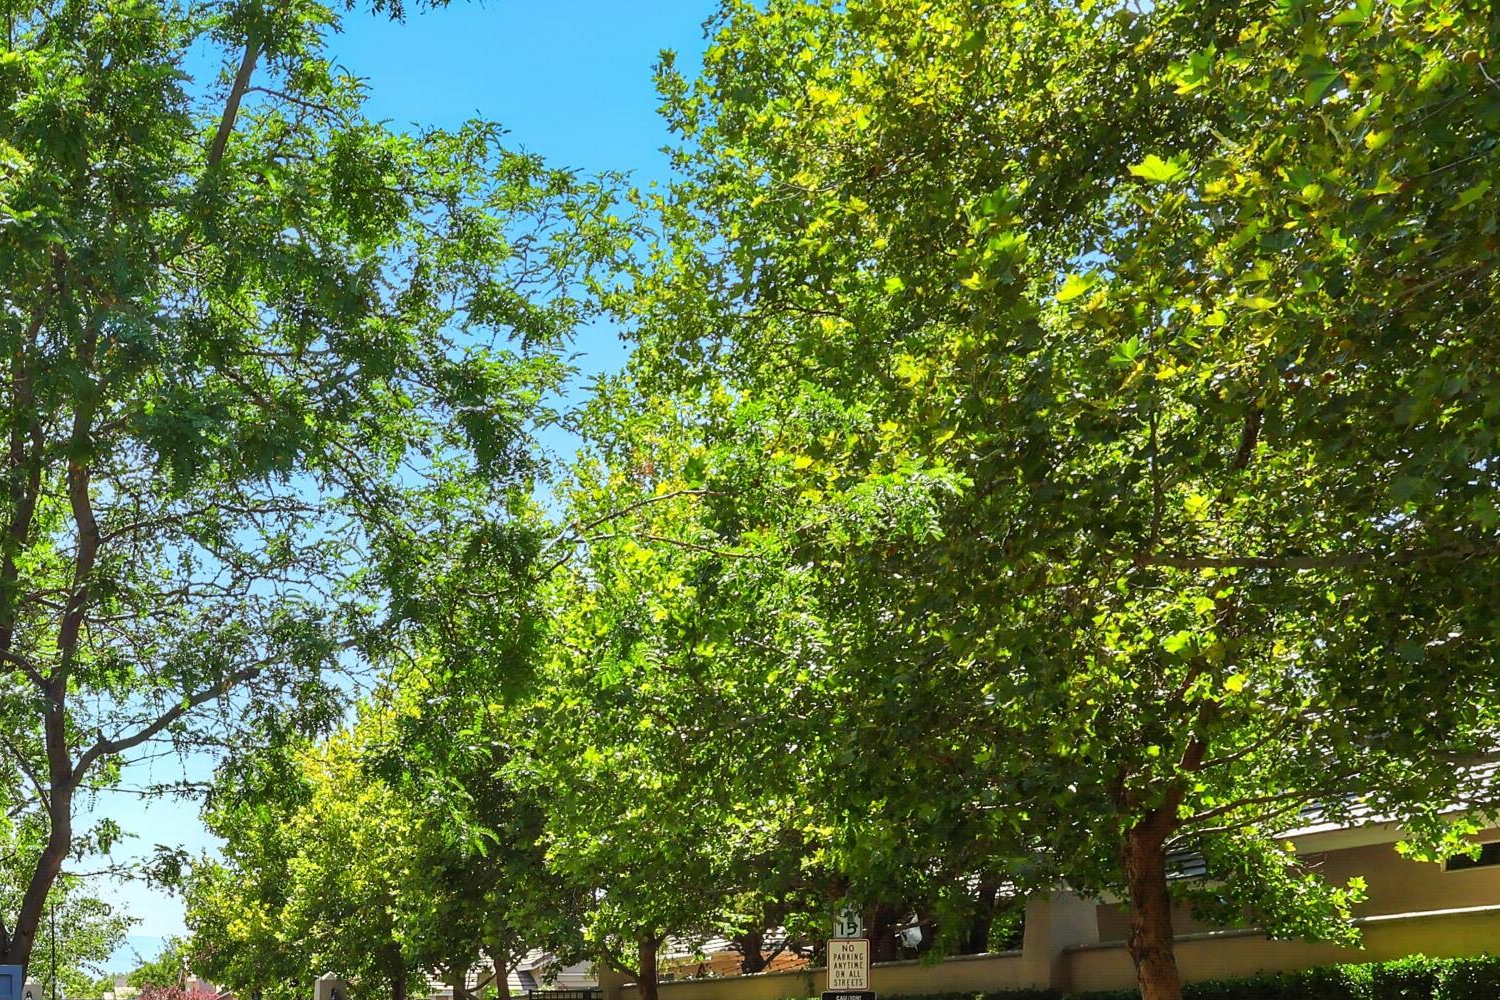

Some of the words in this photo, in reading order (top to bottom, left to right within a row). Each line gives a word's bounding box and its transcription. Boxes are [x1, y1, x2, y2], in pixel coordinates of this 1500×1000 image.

[840, 921, 858, 936] 15
[842, 944, 855, 953] NO
[833, 953, 864, 961] PARKING
[833, 961, 864, 969] ANYTIME
[835, 970, 845, 978] ON
[849, 970, 861, 978] ALL
[833, 978, 863, 987] STREETS
